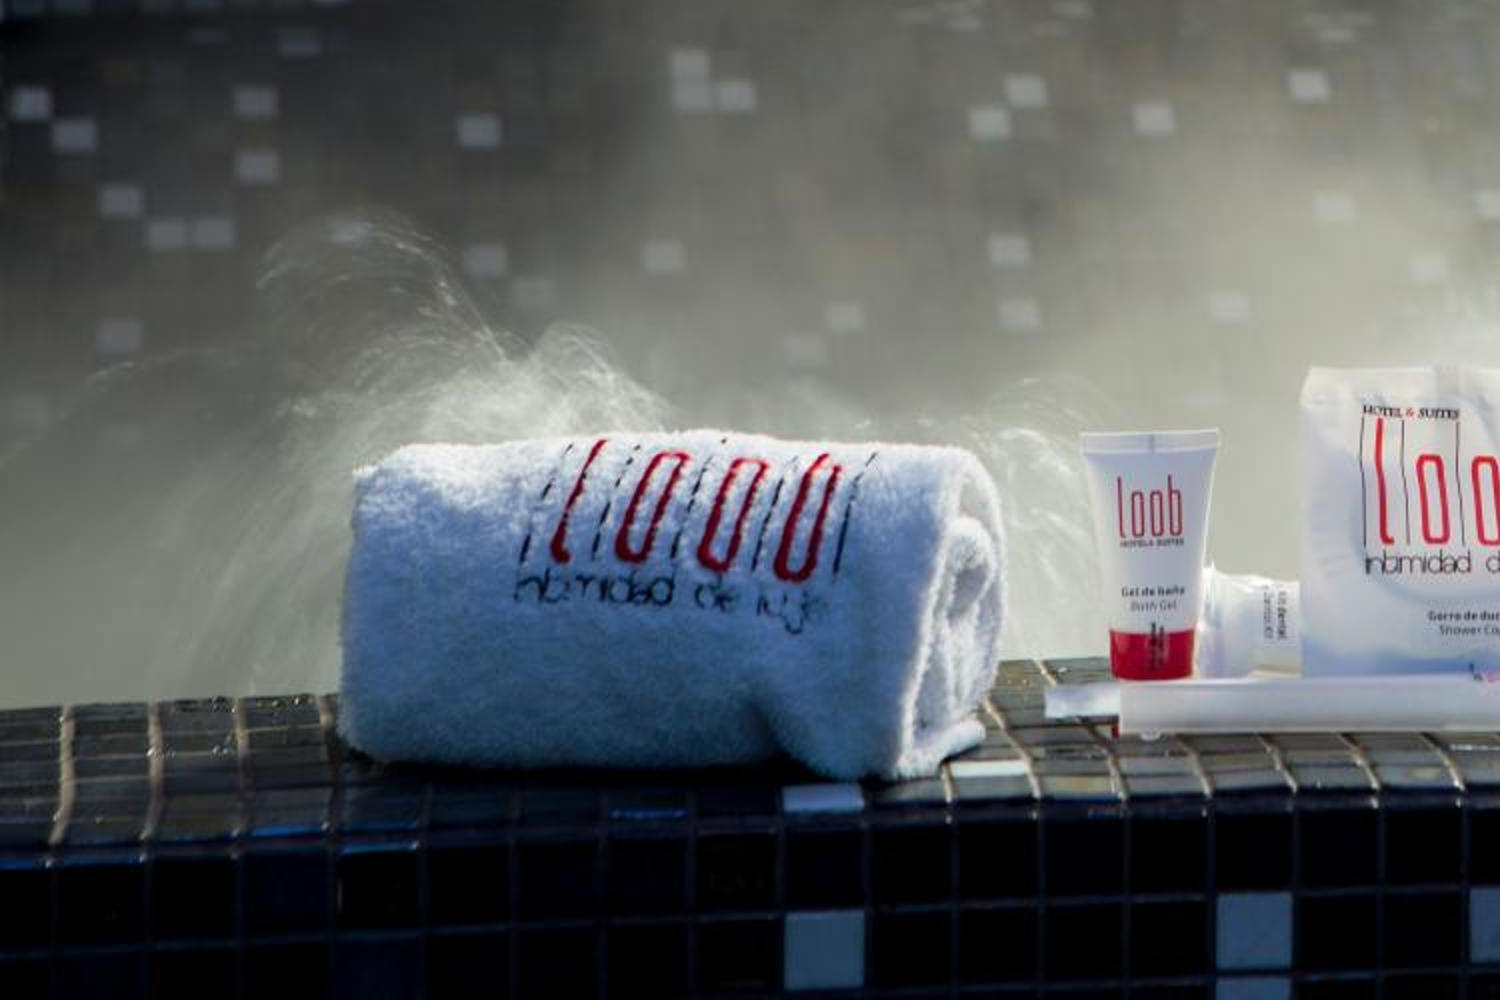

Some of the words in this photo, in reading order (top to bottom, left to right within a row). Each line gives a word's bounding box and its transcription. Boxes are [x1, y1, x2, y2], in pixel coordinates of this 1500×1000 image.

[1362, 404, 1401, 417] HOTEL
[1418, 407, 1460, 419] SUITES
[1116, 473, 1184, 538] loob
[1364, 548, 1472, 575] intimidad
[1428, 609, 1461, 621] Gorro
[1463, 609, 1478, 621] de
[1439, 624, 1481, 636] Shower
